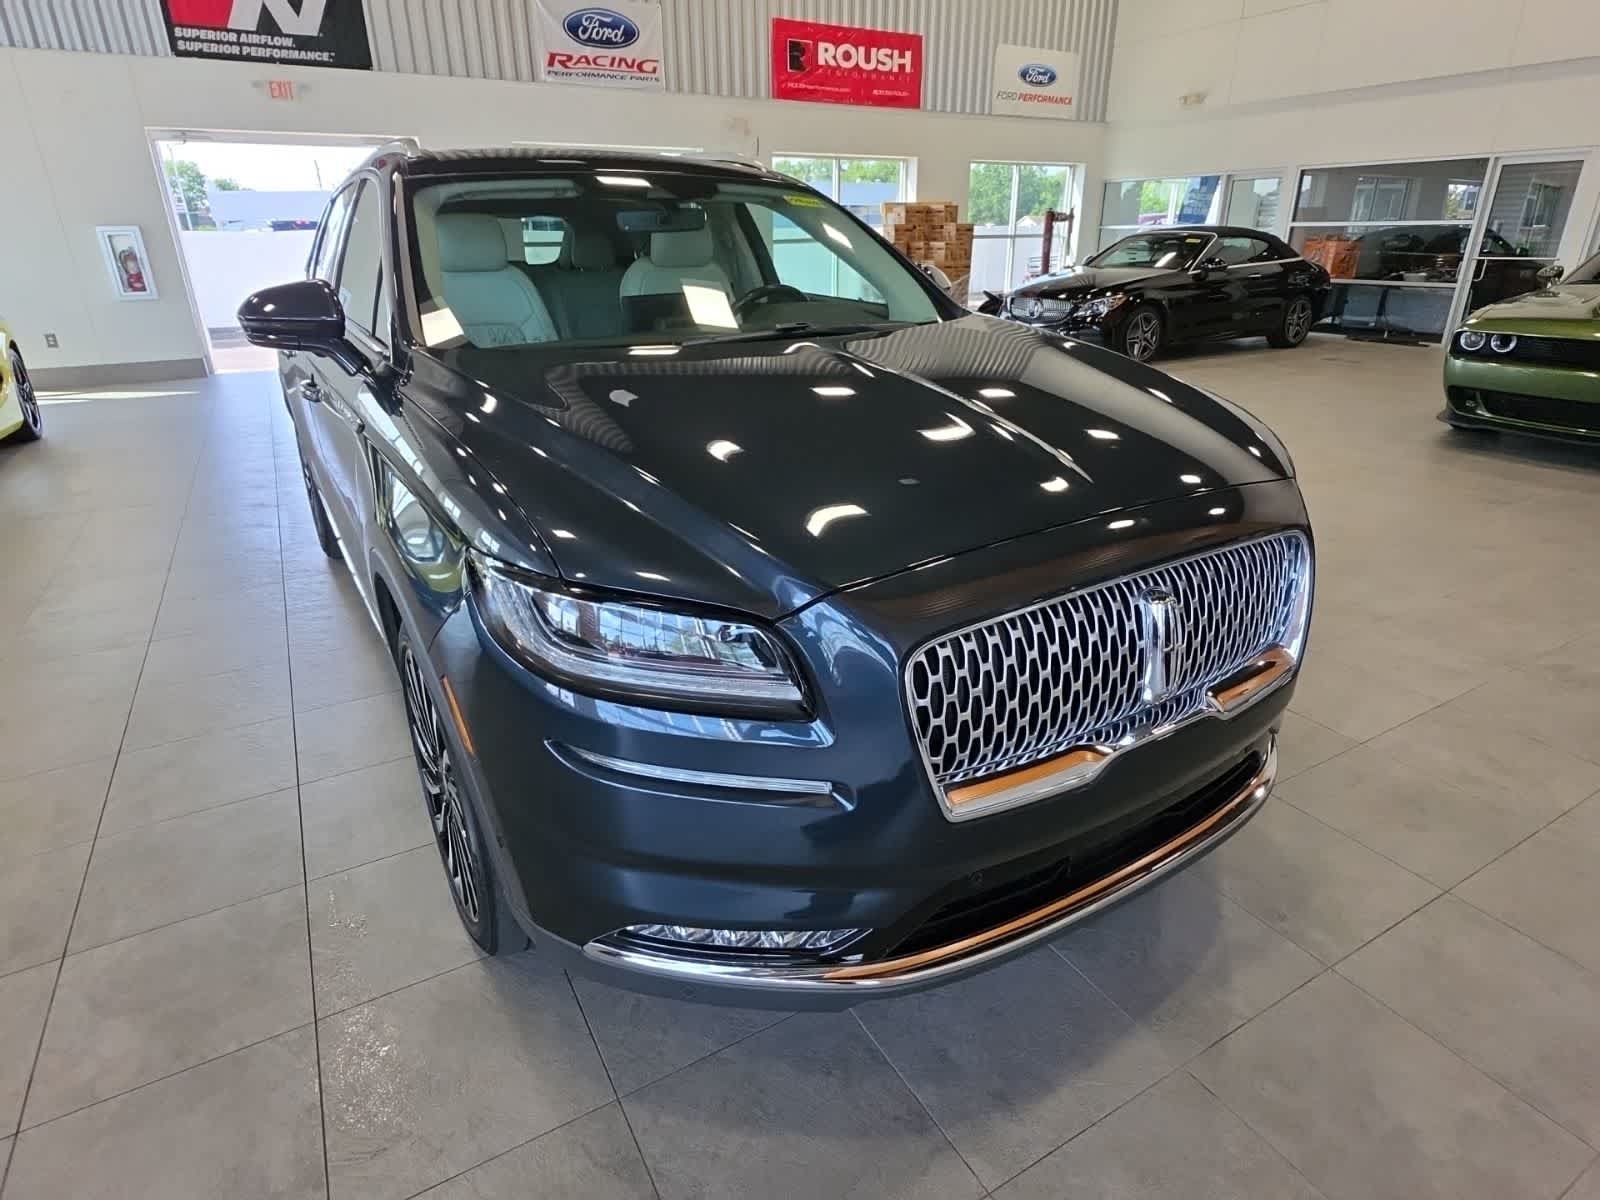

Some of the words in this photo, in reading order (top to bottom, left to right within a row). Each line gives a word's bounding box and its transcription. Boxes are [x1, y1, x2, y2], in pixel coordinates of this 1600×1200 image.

[174, 27, 238, 43] SUPERIOR
[239, 33, 296, 48] AIRFLOW.
[578, 13, 625, 42] Ford
[177, 40, 240, 55] SUPERIOR
[817, 41, 912, 73] ROUSH
[547, 52, 659, 74] RACING
[547, 70, 627, 81] PERFORMANCE
[1026, 67, 1050, 83] Ford
[268, 80, 294, 101] EXIT
